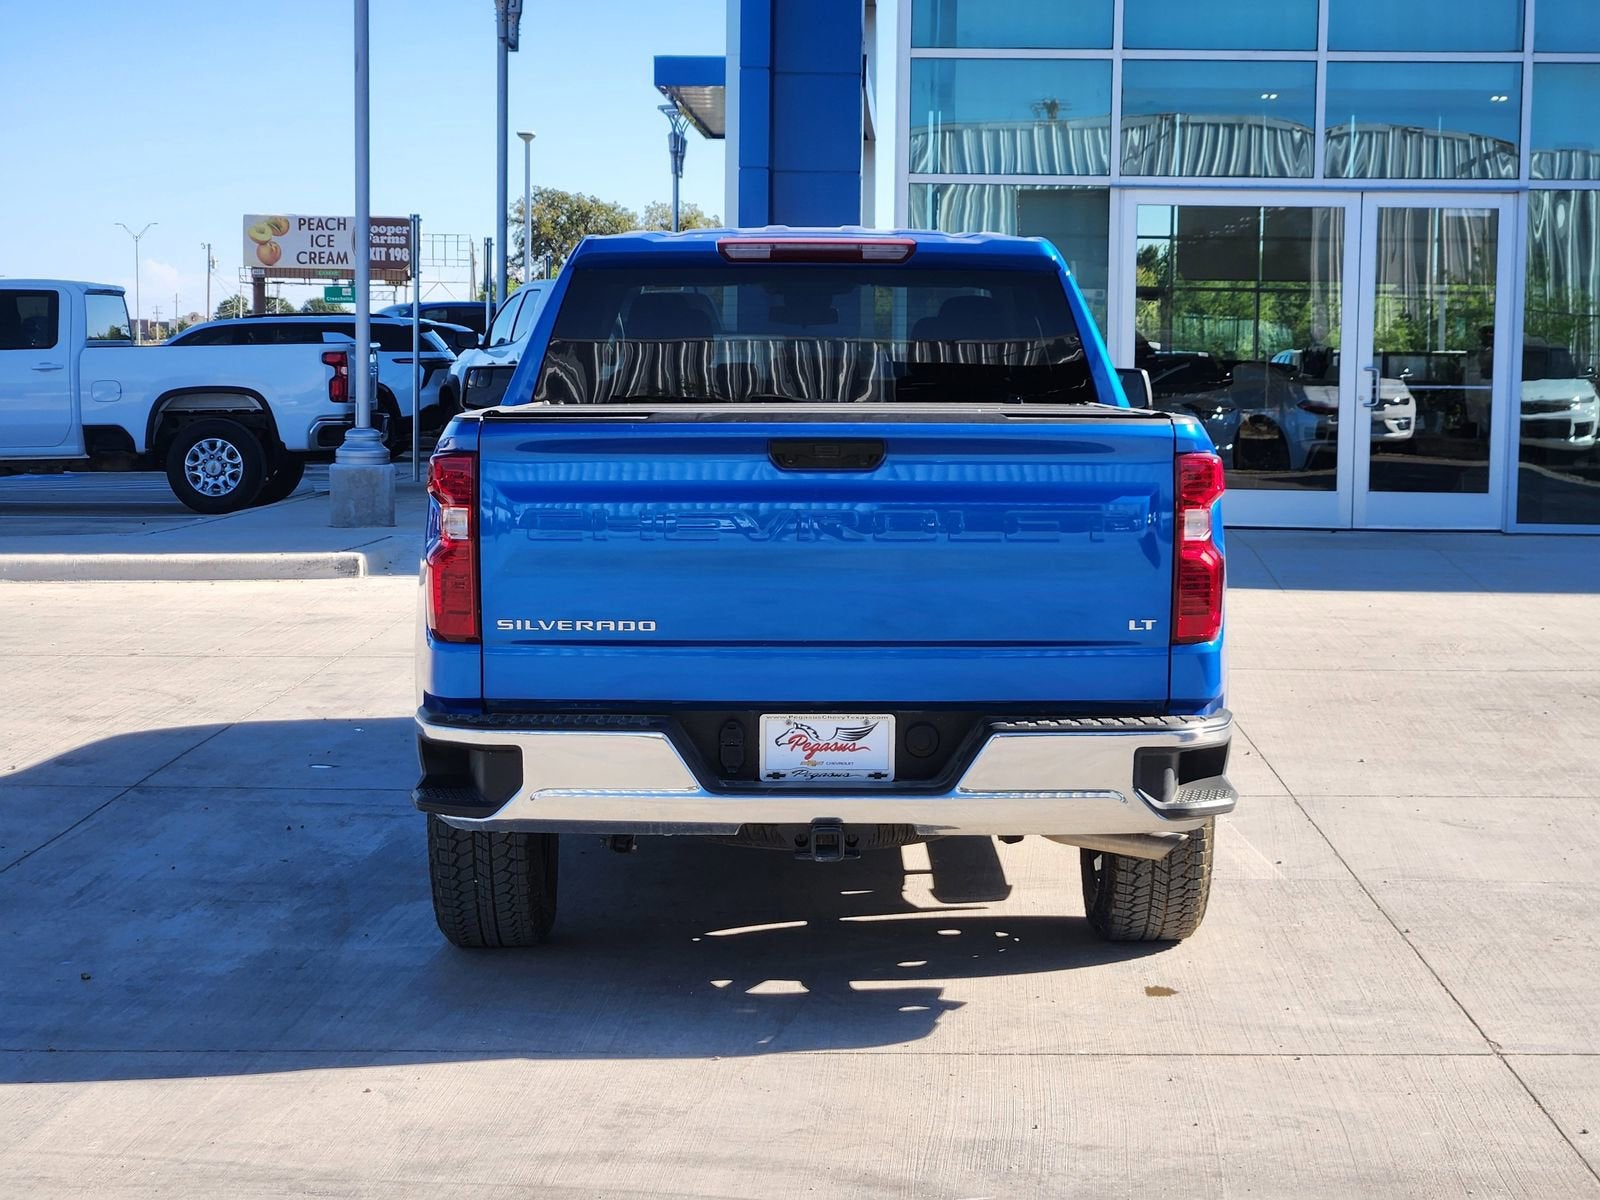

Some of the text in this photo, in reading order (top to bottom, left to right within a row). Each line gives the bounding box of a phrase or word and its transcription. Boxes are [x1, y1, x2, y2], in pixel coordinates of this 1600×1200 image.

[298, 217, 347, 231] PEACH
[369, 225, 410, 236] ooper
[310, 234, 335, 248] ICE
[369, 233, 407, 244] arms
[296, 251, 349, 265] CREAM
[369, 247, 410, 262] XIT 198
[525, 507, 1130, 542] CHEVROLET
[496, 619, 657, 632] SILVERADO
[1128, 619, 1158, 631] LT
[787, 734, 871, 760] Pegasus
[791, 768, 862, 781] Pegasus
